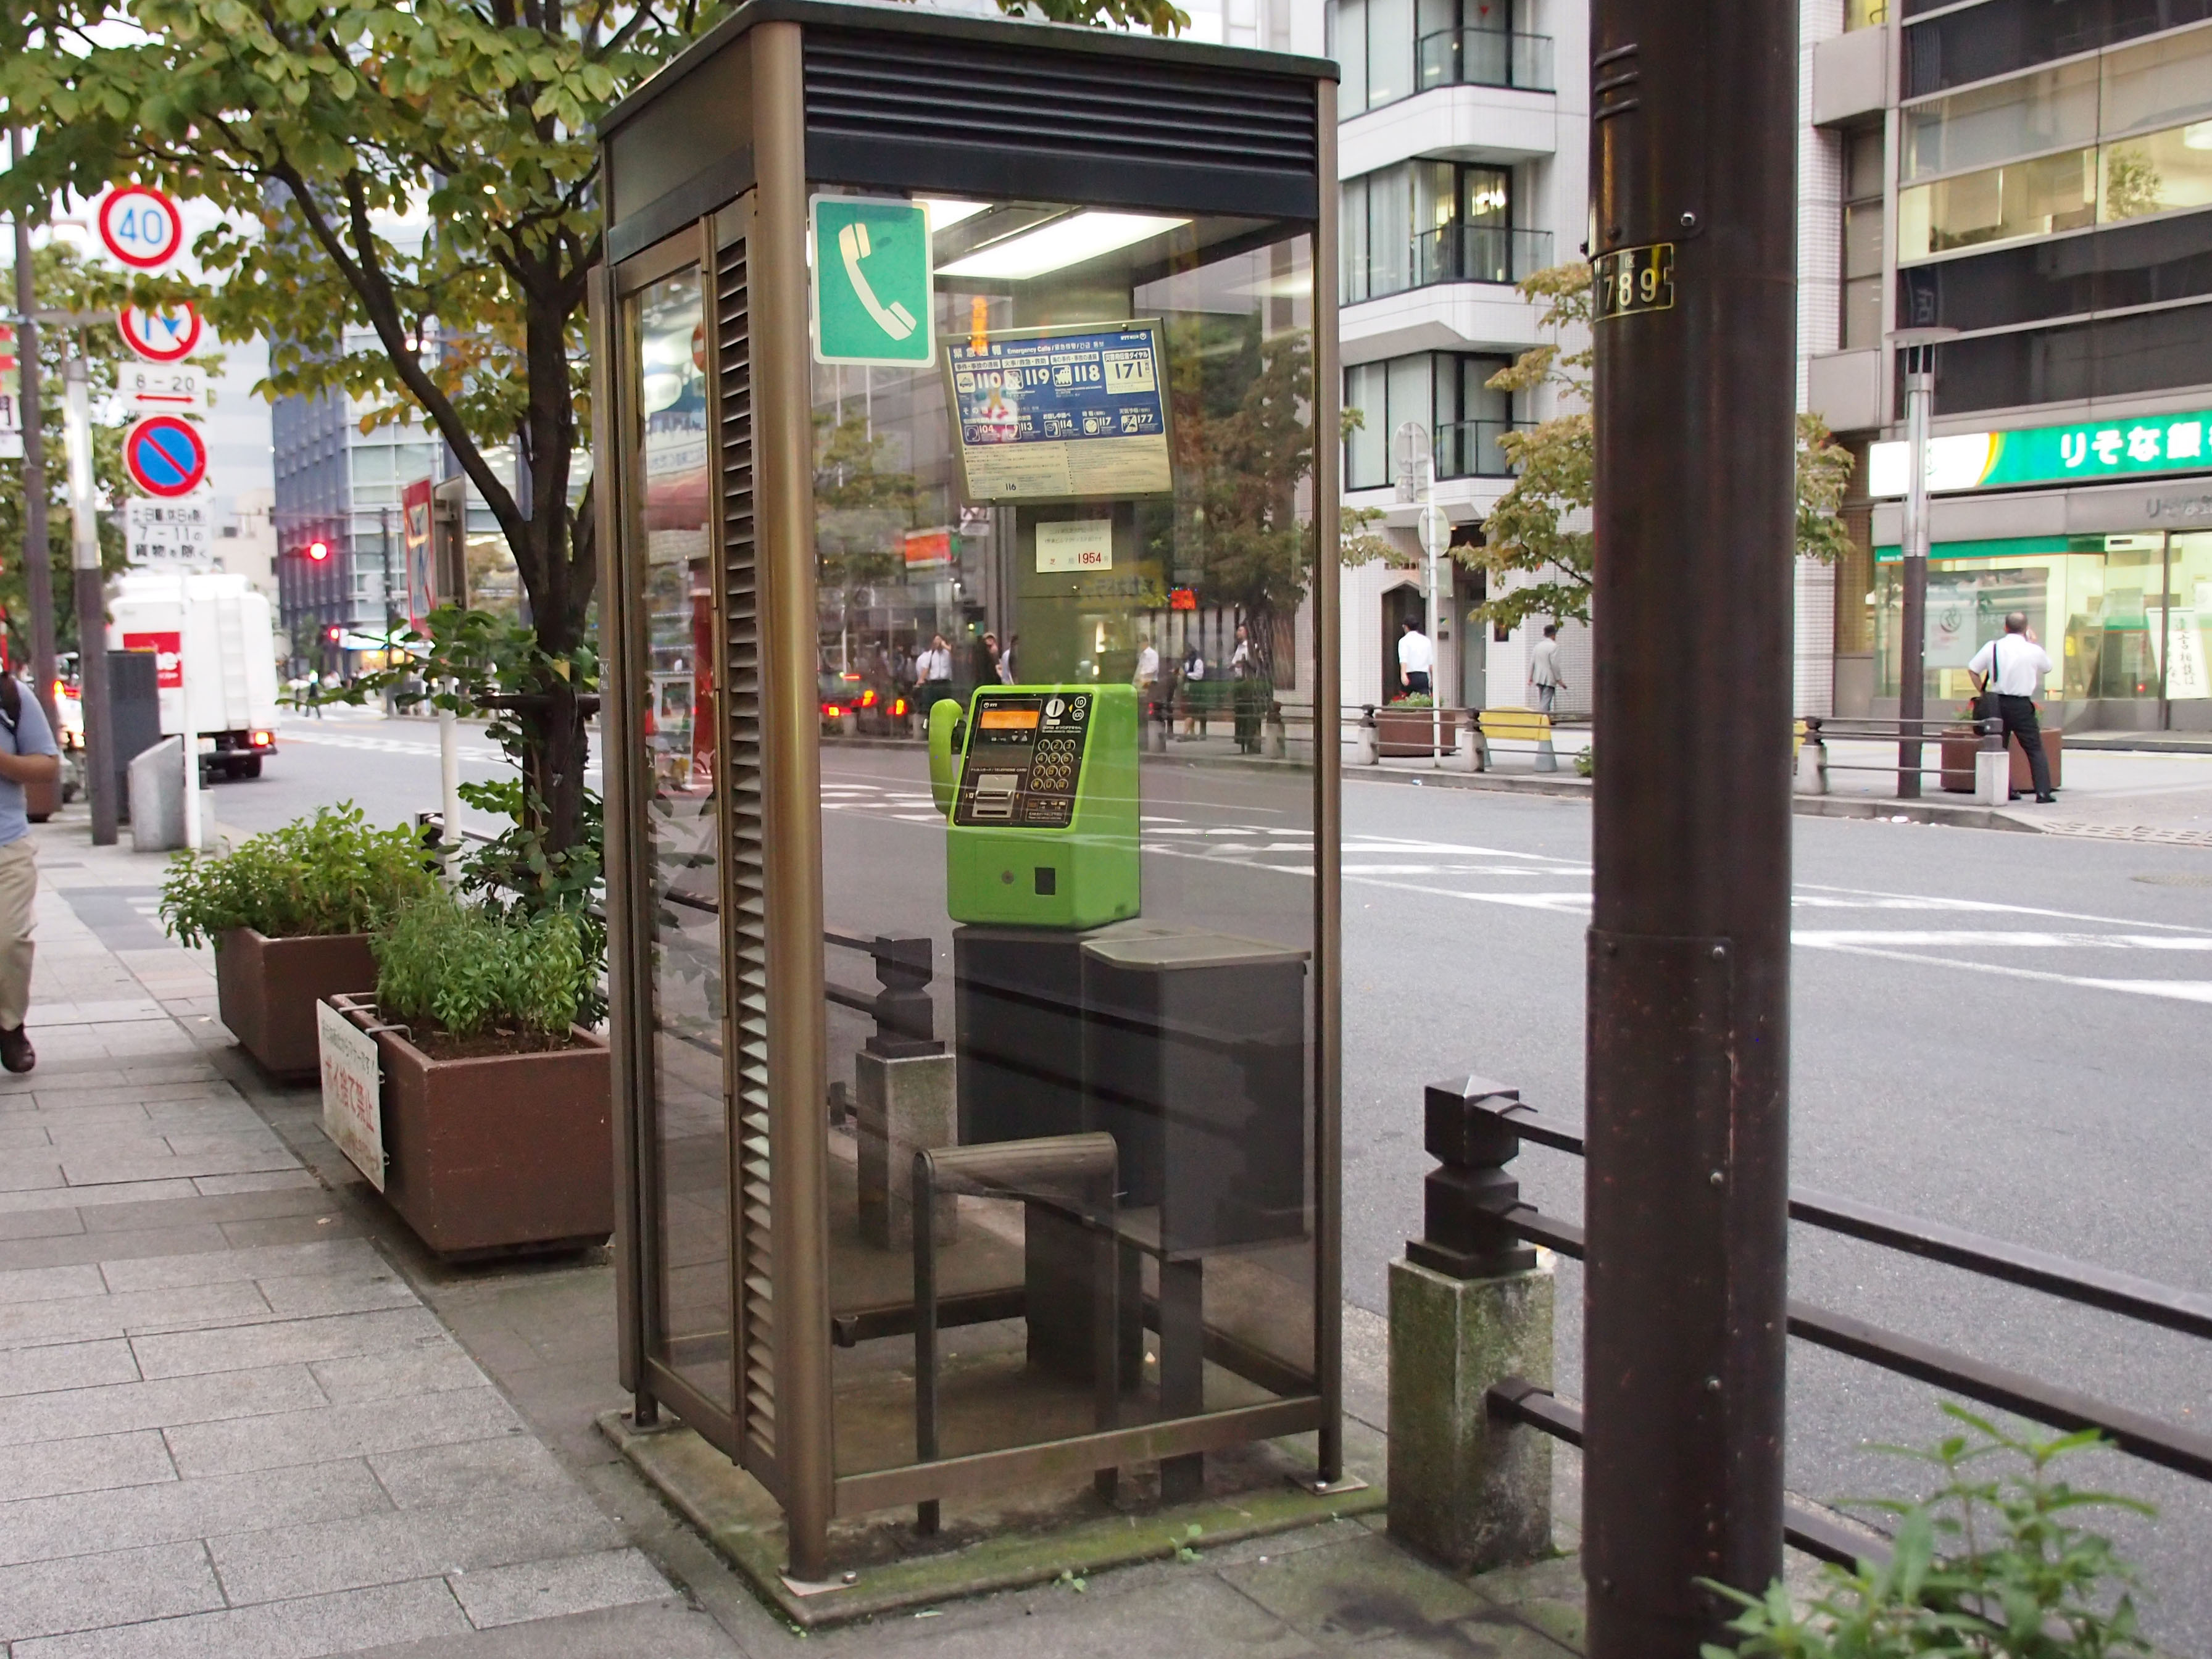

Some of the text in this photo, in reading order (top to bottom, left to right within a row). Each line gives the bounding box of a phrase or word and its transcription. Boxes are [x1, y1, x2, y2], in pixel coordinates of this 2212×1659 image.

[119, 208, 163, 244] 40
[1007, 345, 1037, 355] Emergency
[1037, 344, 1051, 352] Calls
[1074, 364, 1100, 383] 118
[1115, 361, 1142, 379] 171
[977, 372, 1002, 389] 110
[1025, 368, 1050, 386] 119
[1099, 417, 1112, 426] 117
[1137, 414, 1154, 423] 177
[979, 425, 994, 433] 104
[1021, 422, 1033, 431] 113
[1060, 420, 1073, 429] 114
[2060, 422, 2212, 468] りそな銀
[1005, 483, 1017, 491] 116
[1078, 552, 1102, 564] 1954
